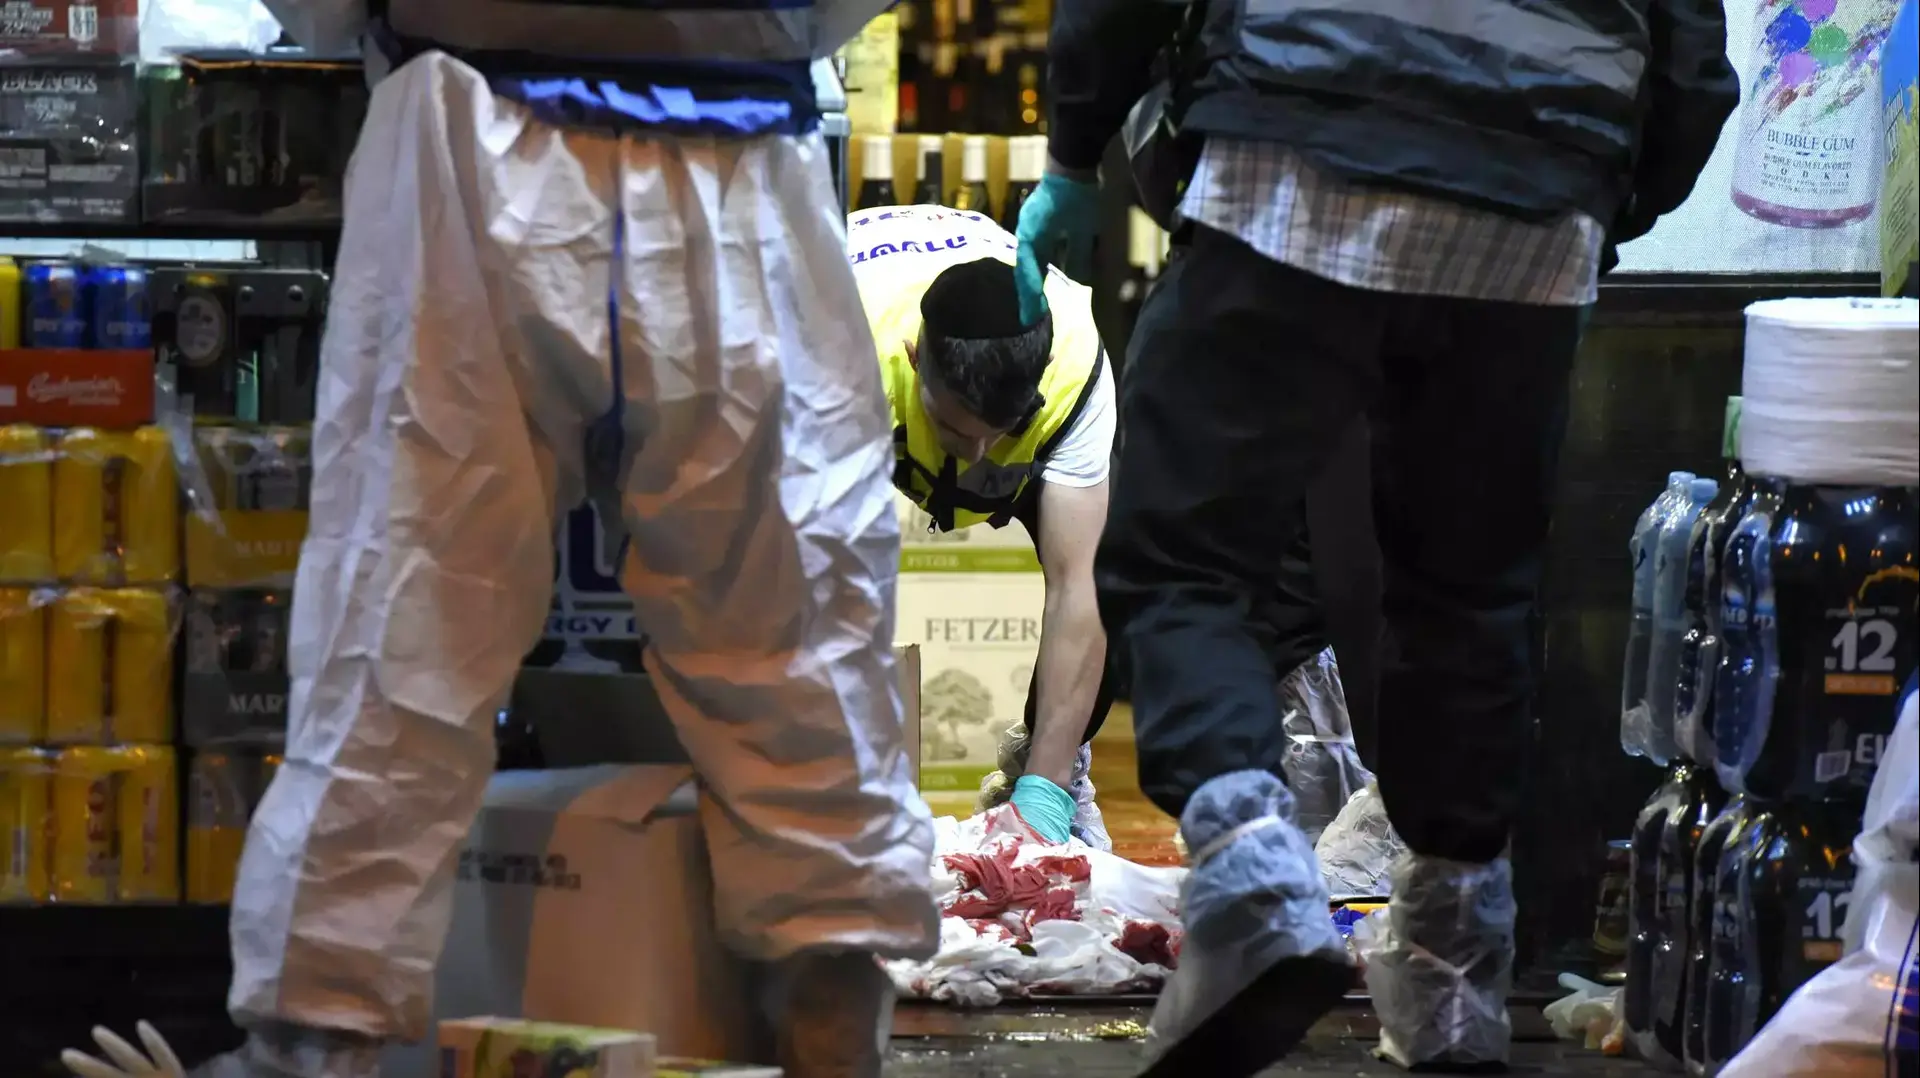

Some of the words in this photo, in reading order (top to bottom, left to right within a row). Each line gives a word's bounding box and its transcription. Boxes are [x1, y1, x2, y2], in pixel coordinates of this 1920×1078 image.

[2, 72, 98, 93] BLACK
[1767, 129, 1819, 150] BUBBLE
[1822, 137, 1856, 151] GUM
[925, 617, 1038, 642] FETZER
